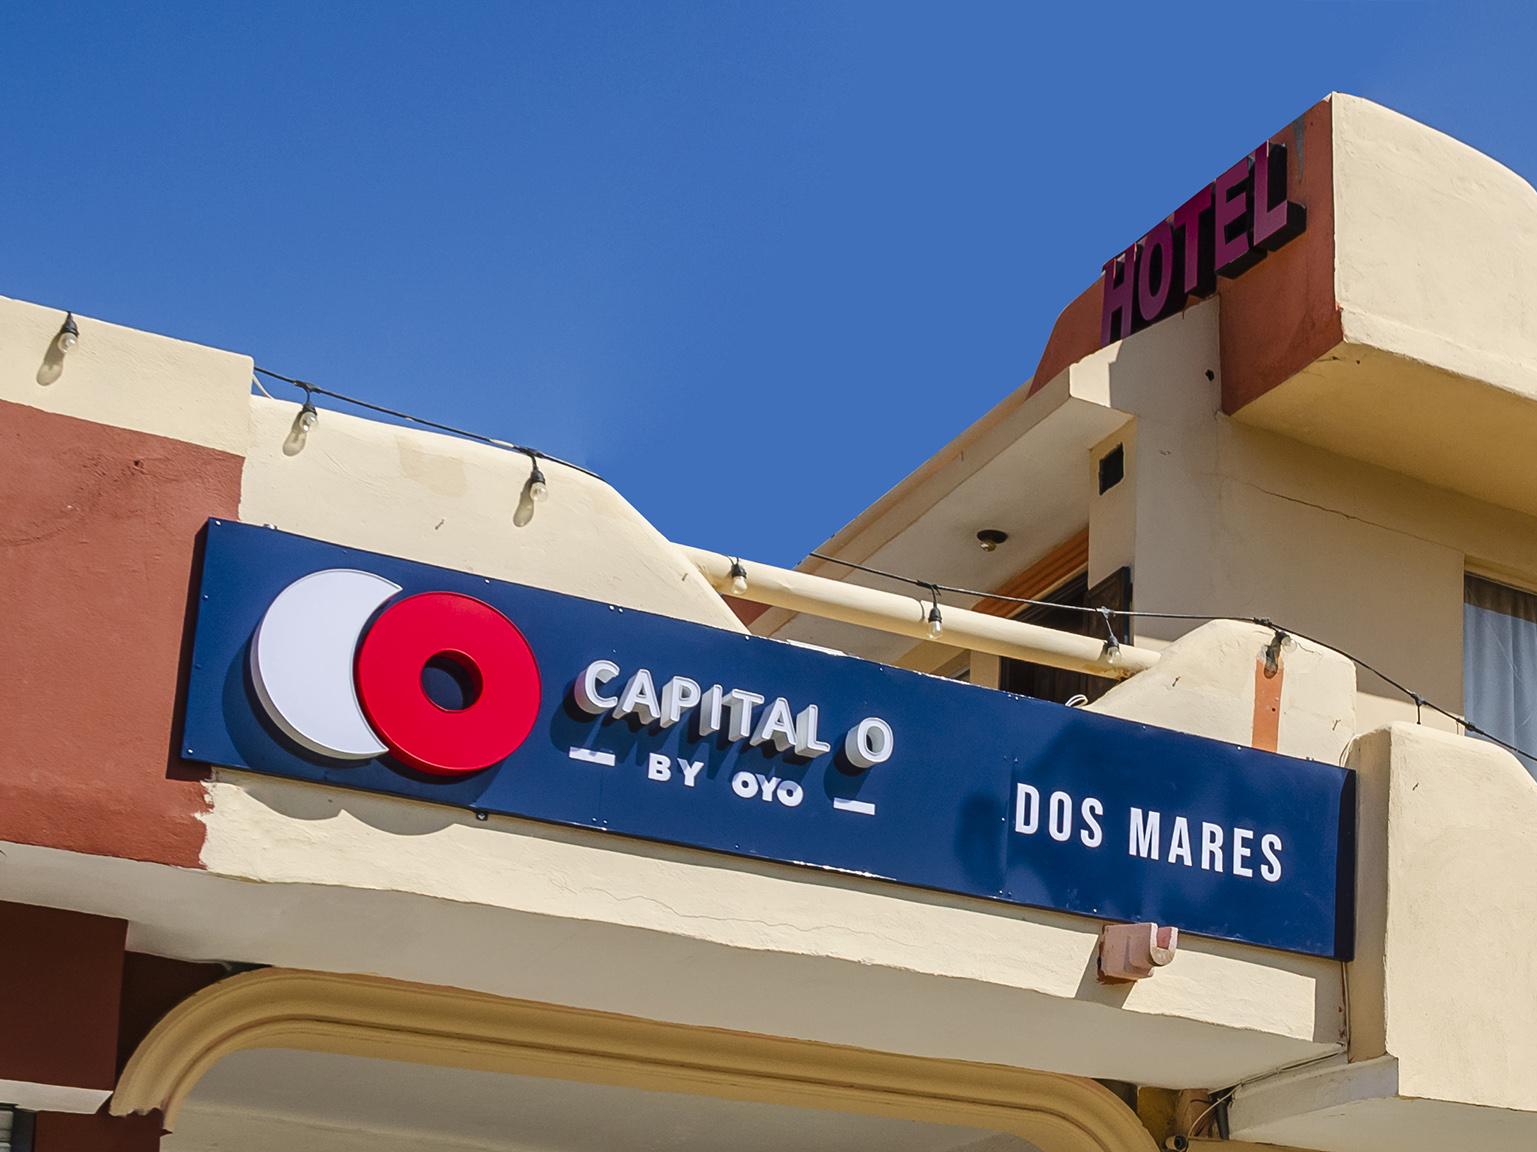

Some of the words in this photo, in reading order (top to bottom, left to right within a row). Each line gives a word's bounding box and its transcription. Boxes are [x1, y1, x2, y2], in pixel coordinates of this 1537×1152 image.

[1100, 139, 1302, 346] HOTEL
[575, 660, 831, 758] CAPITAL
[845, 717, 894, 768] O
[648, 752, 704, 787] BY
[731, 770, 804, 807] OYO
[1015, 783, 1104, 848] DOS
[1129, 807, 1282, 883] MARES
